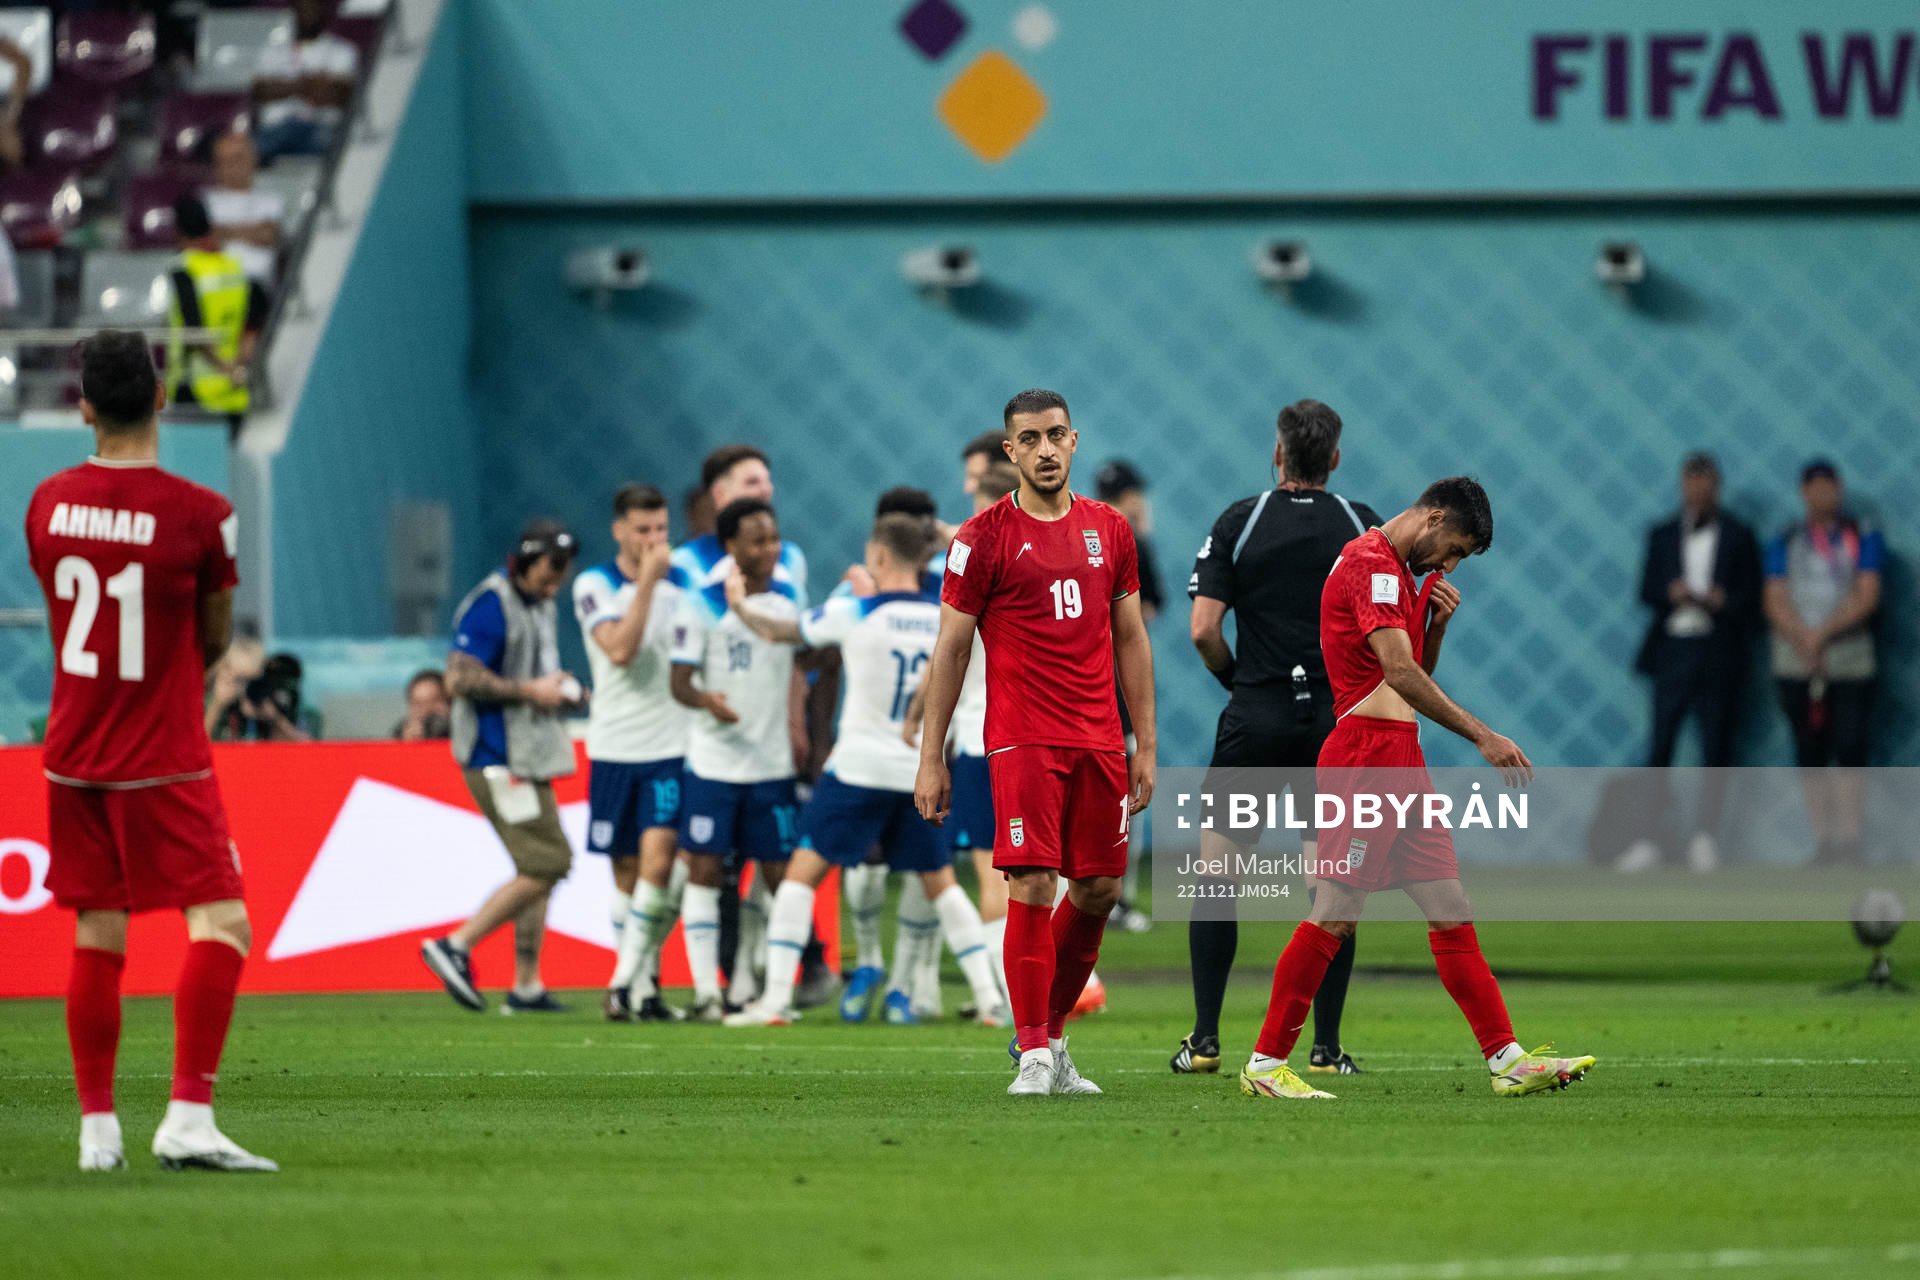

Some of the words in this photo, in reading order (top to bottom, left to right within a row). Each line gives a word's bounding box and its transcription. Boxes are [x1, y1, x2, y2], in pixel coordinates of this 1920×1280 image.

[1529, 30, 1785, 122] FIFA
[1800, 30, 1920, 122] W
[48, 502, 156, 545] AHMAD
[55, 555, 145, 682] 21
[1049, 578, 1084, 620] 19
[1119, 794, 1130, 833] 1
